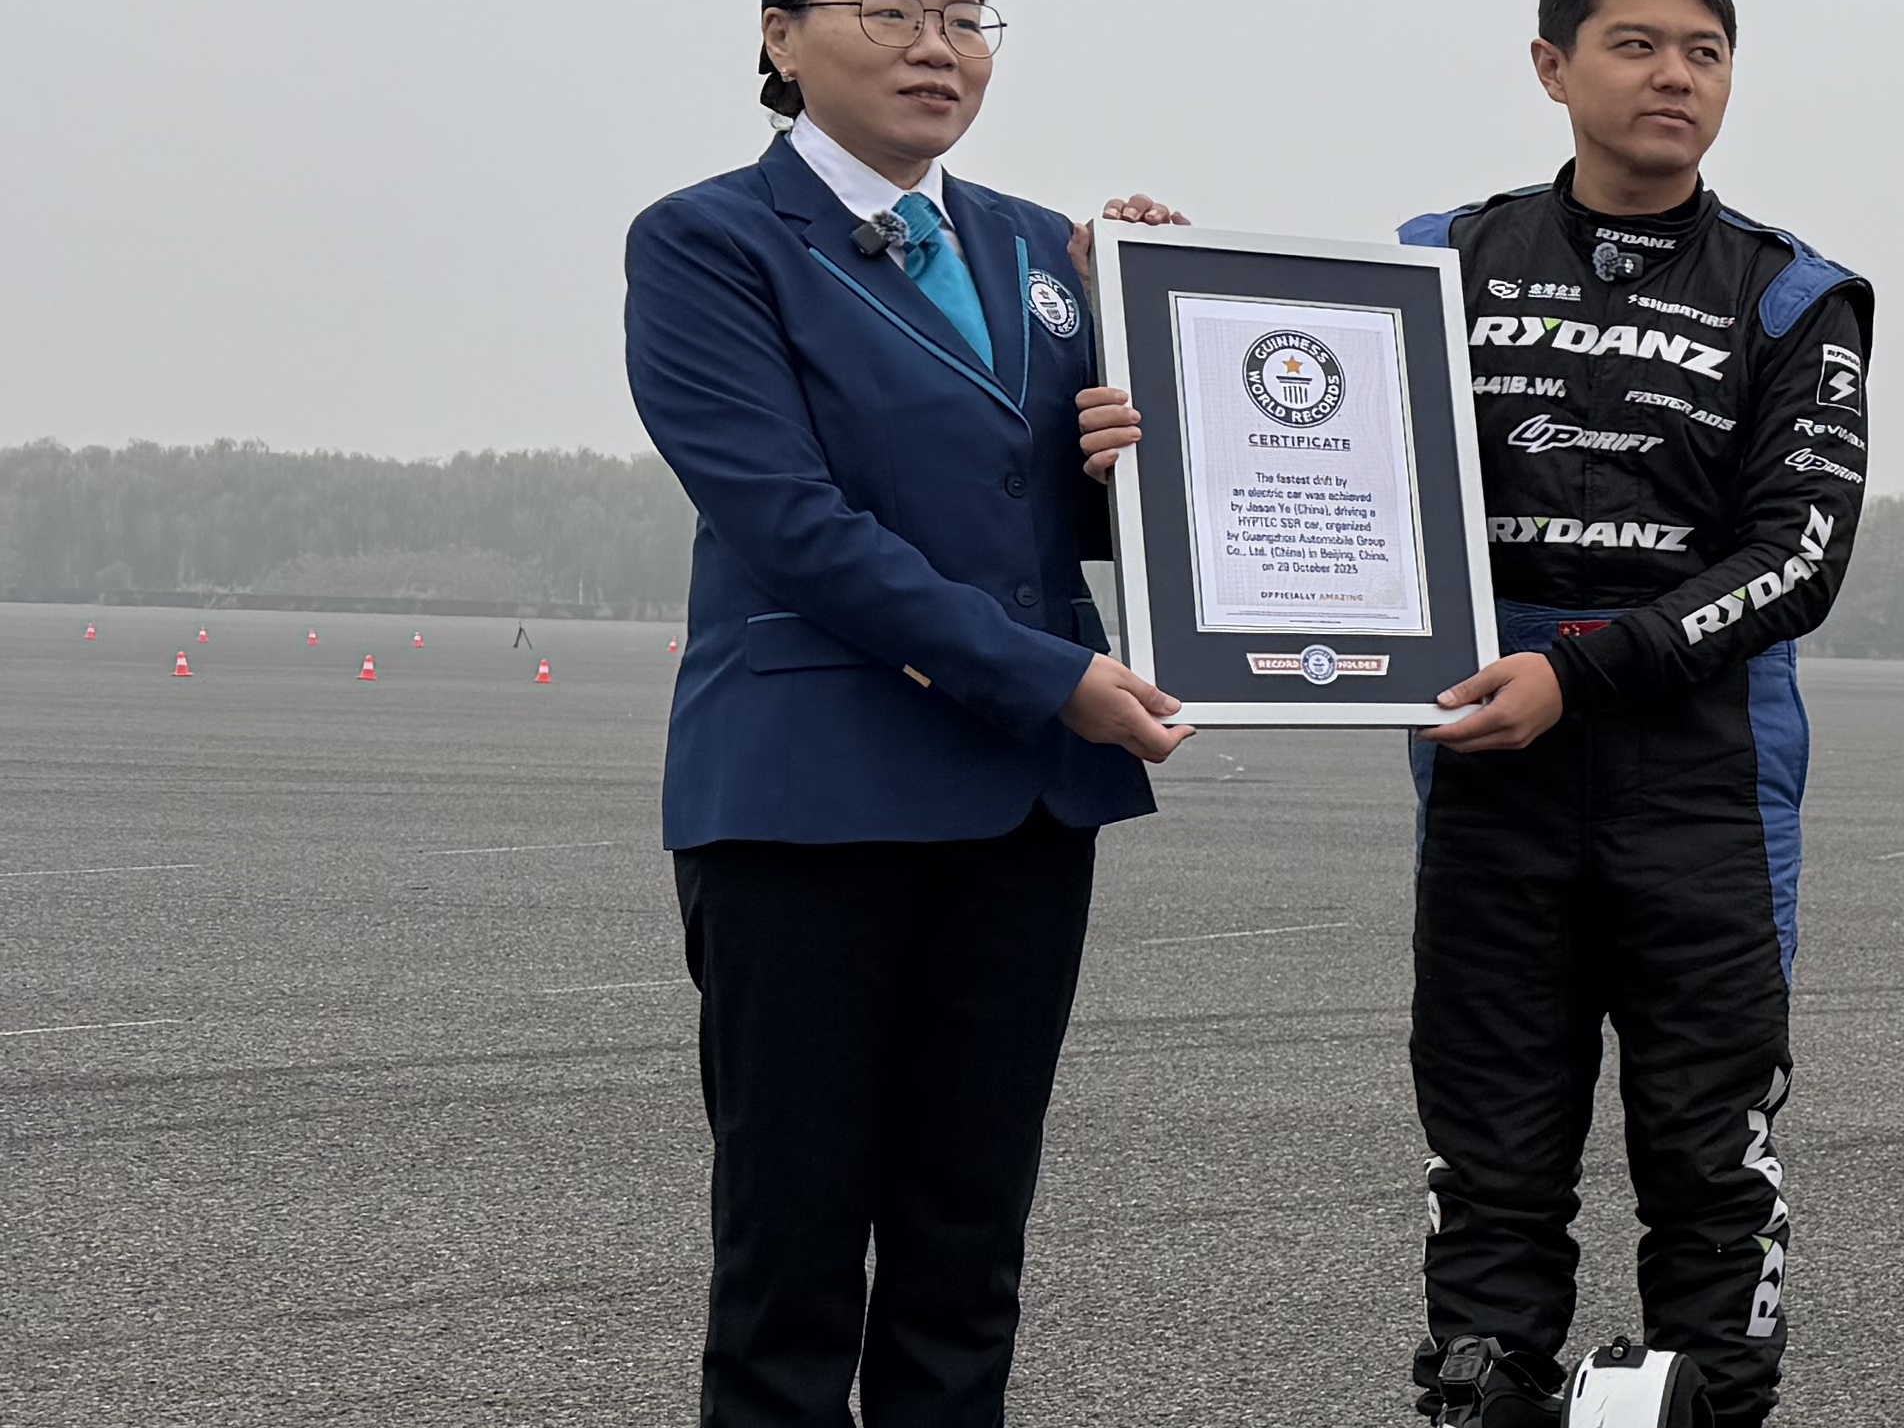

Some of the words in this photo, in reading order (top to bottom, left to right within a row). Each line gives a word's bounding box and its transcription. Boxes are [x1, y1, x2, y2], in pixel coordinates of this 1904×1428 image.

[1595, 227, 1677, 250] RYDANZ
[1254, 335, 1330, 363] GUINNESS
[1468, 316, 1731, 380] RYDANZ
[1248, 370, 1286, 418] WORLD
[1291, 375, 1340, 423] RECORDS
[1624, 391, 1693, 414] FASTER
[1690, 410, 1737, 431] ADS
[1248, 433, 1351, 450] CERTIFICATE
[1255, 472, 1274, 484] The
[1277, 473, 1310, 486] fastest
[1313, 474, 1333, 486] drift
[1335, 476, 1348, 489] by
[1233, 488, 1245, 497] an
[1248, 487, 1284, 499] electric
[1287, 491, 1302, 500] car
[1305, 491, 1326, 501] was
[1328, 490, 1372, 503] achieved
[1230, 501, 1243, 513] by
[1246, 502, 1276, 514] Jason
[1334, 506, 1368, 519] driving
[1369, 509, 1376, 518] a
[1238, 516, 1277, 528] HYPTEC
[1325, 521, 1372, 534] organized
[1226, 530, 1240, 542] by
[1242, 531, 1296, 545] Guangzhou
[1298, 533, 1354, 546] Automobile
[1356, 535, 1386, 548] Group
[1486, 516, 1695, 553] RYDANZ
[1249, 546, 1268, 557] Ltd.
[1270, 547, 1306, 560] (China)
[1308, 548, 1318, 559] in
[1262, 563, 1275, 572] on
[1292, 562, 1331, 574] October
[1680, 503, 1835, 647] RYDANZ
[1260, 590, 1316, 600] OFFICIALLY
[1318, 592, 1365, 602] AMAZING
[1257, 658, 1300, 669] RECORD
[1338, 659, 1379, 670] HOLDER
